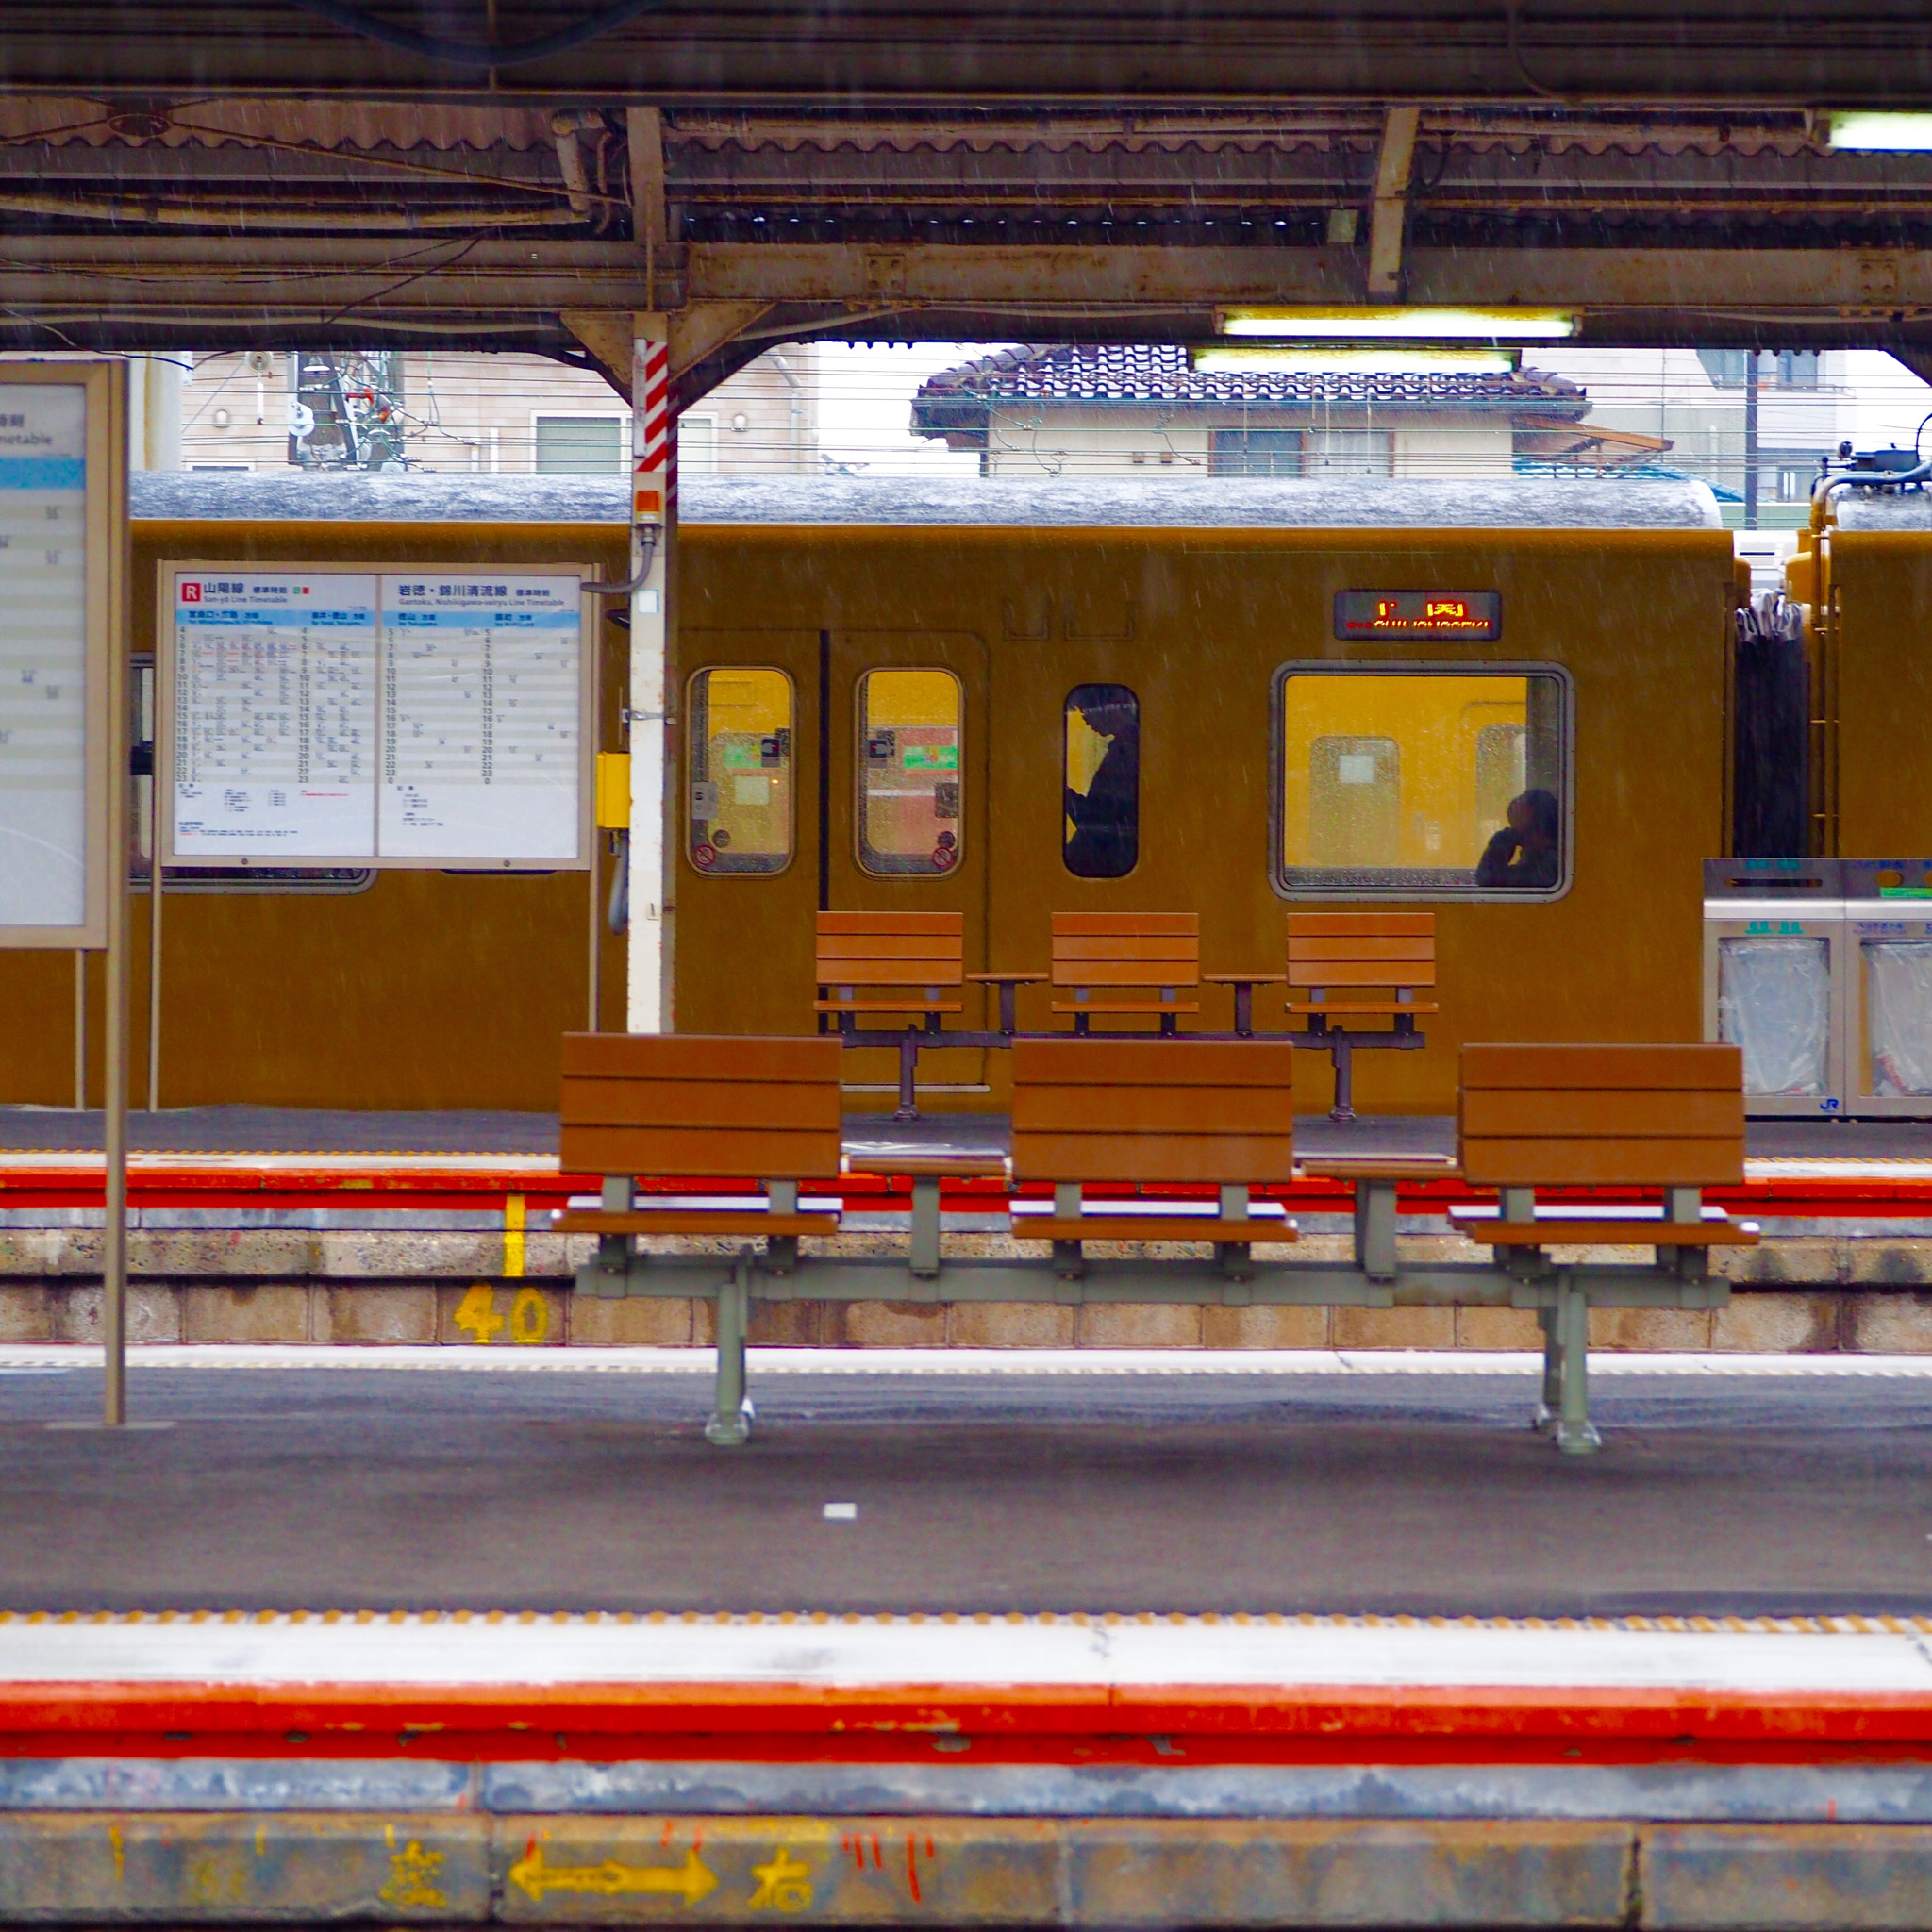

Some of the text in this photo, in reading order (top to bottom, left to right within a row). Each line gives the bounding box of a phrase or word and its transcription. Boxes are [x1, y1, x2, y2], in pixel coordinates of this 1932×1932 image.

[203, 582, 244, 594] 山陽線
[1819, 1098, 1839, 1110] JR
[453, 1281, 550, 1343] 40
